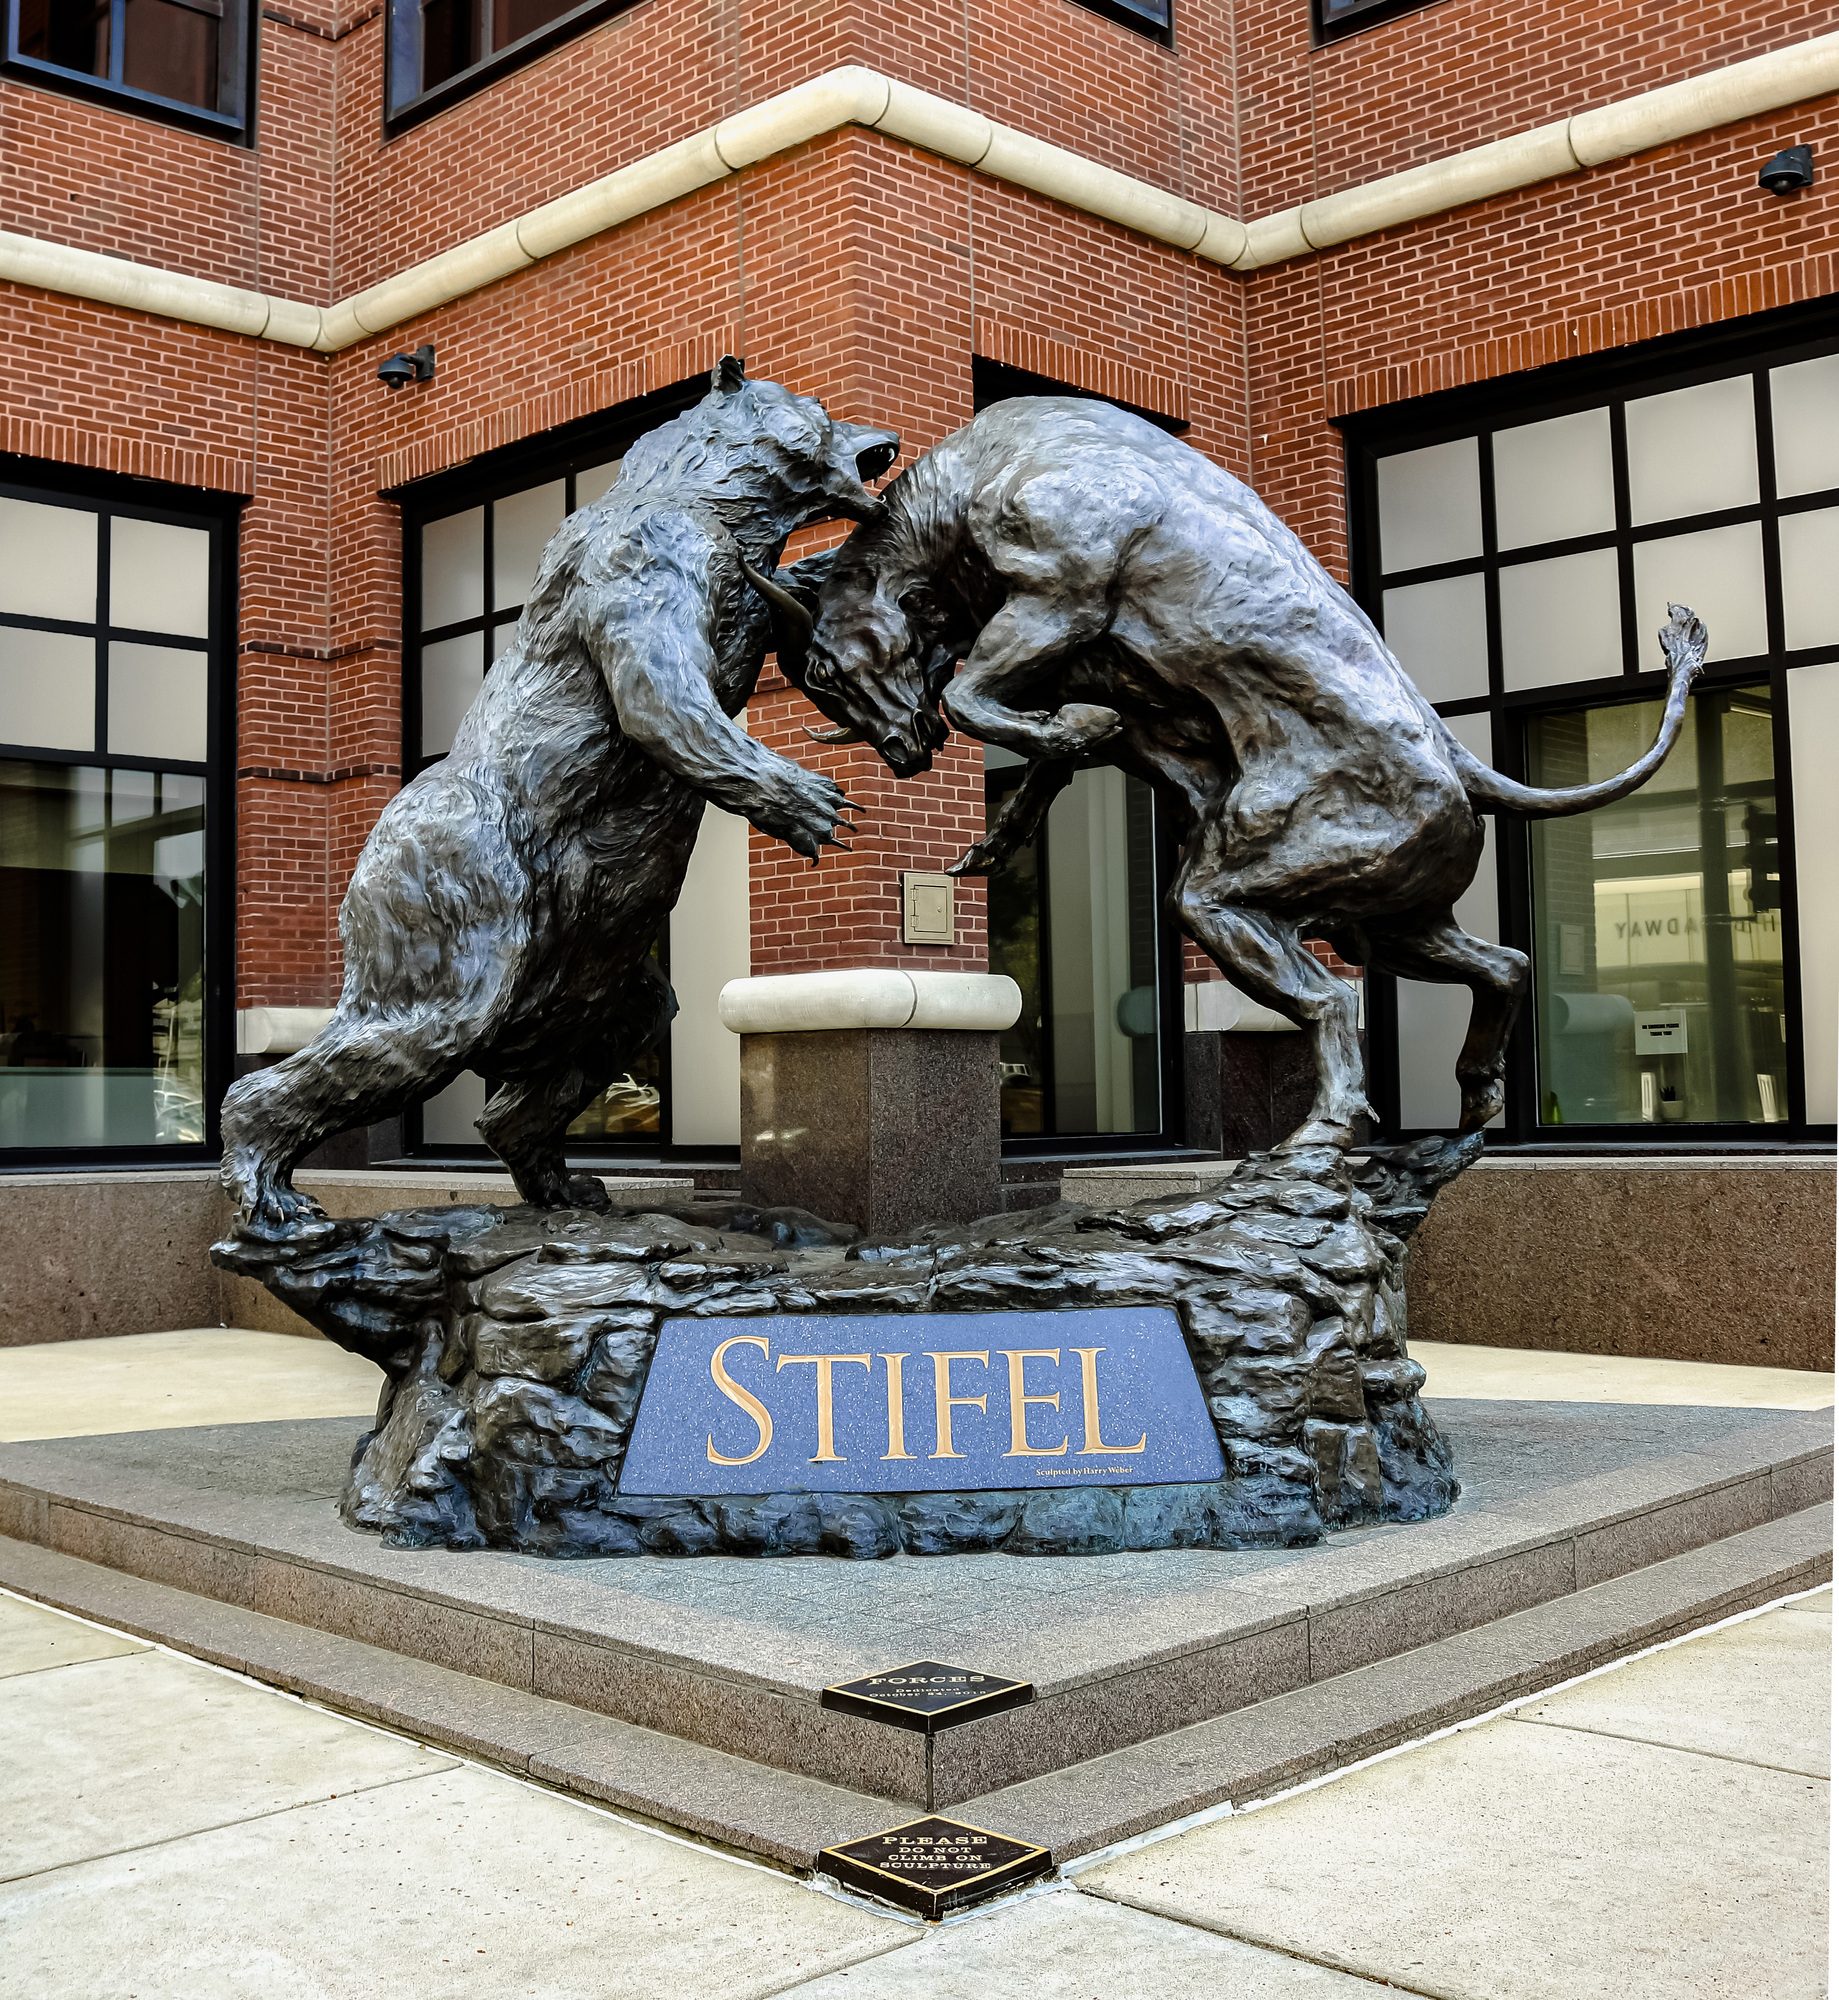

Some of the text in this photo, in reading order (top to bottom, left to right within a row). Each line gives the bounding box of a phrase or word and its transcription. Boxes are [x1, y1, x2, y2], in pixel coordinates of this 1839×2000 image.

[706, 1335, 1147, 1466] STIFEL
[1035, 1466, 1134, 1477] Sculpted by Harry Weber
[867, 1675, 985, 1685] FORCES
[882, 1836, 988, 1845] PLEASE
